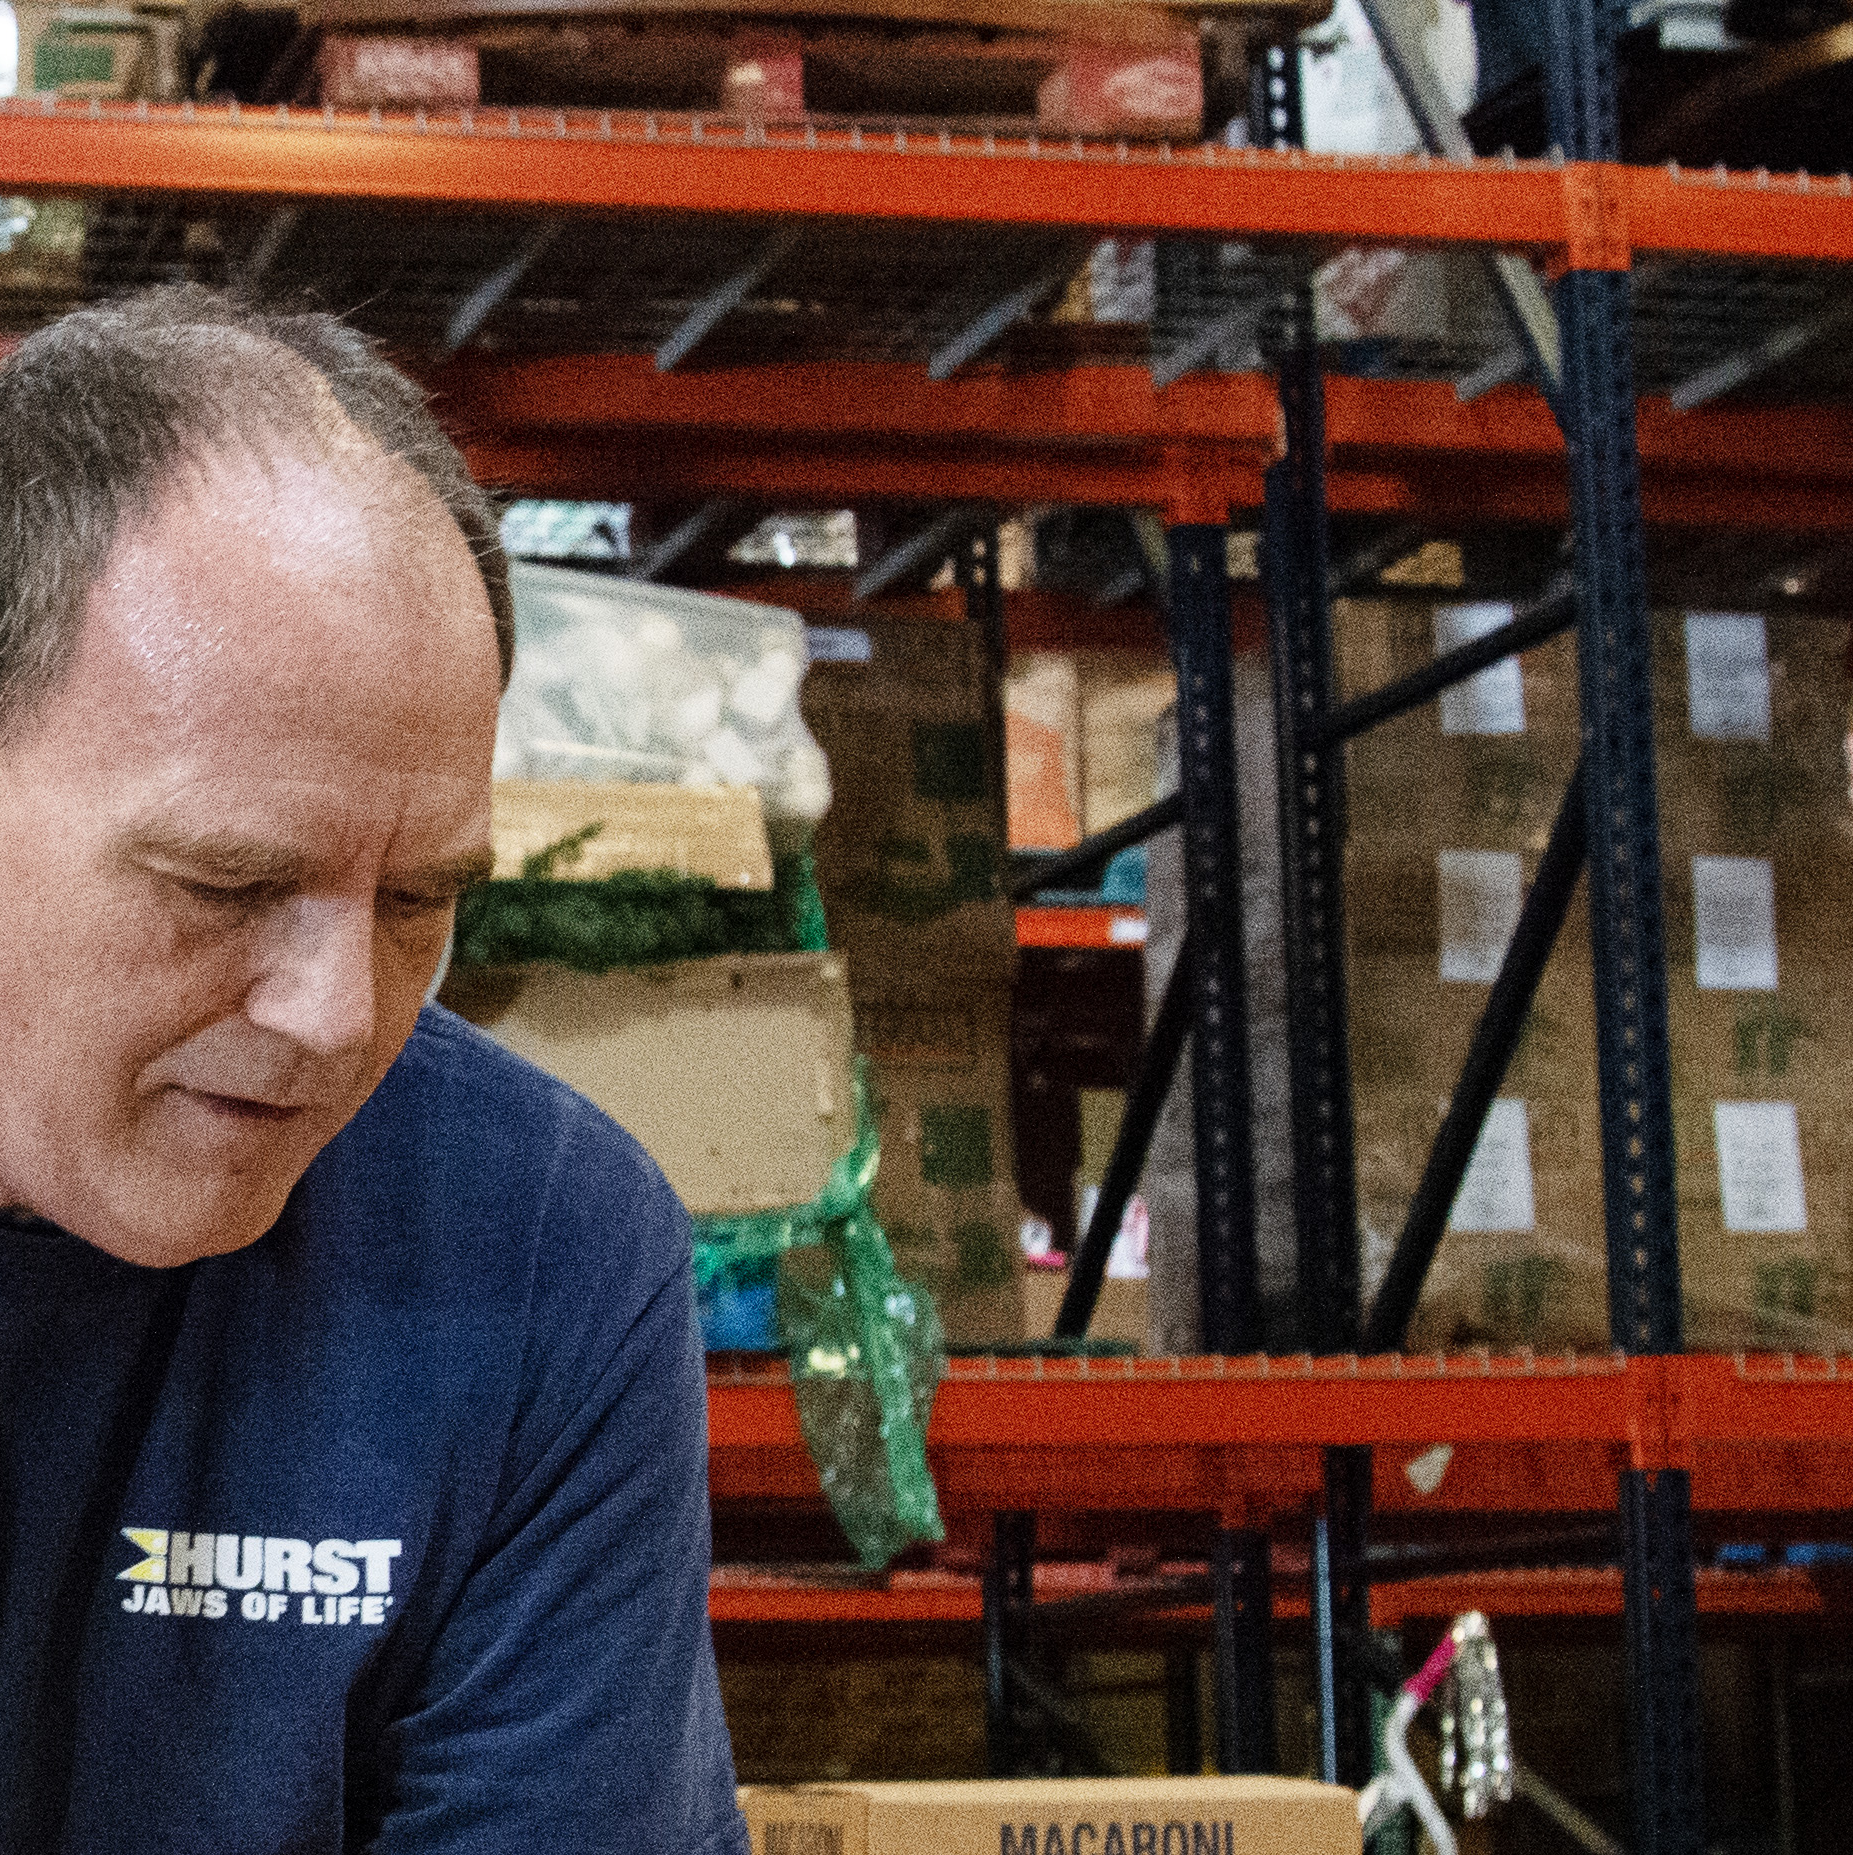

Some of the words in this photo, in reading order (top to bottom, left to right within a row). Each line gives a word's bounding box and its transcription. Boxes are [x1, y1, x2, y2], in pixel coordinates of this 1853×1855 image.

[169, 1531, 402, 1594] HURST
[120, 1585, 228, 1620] JAWS
[240, 1591, 289, 1623] OF
